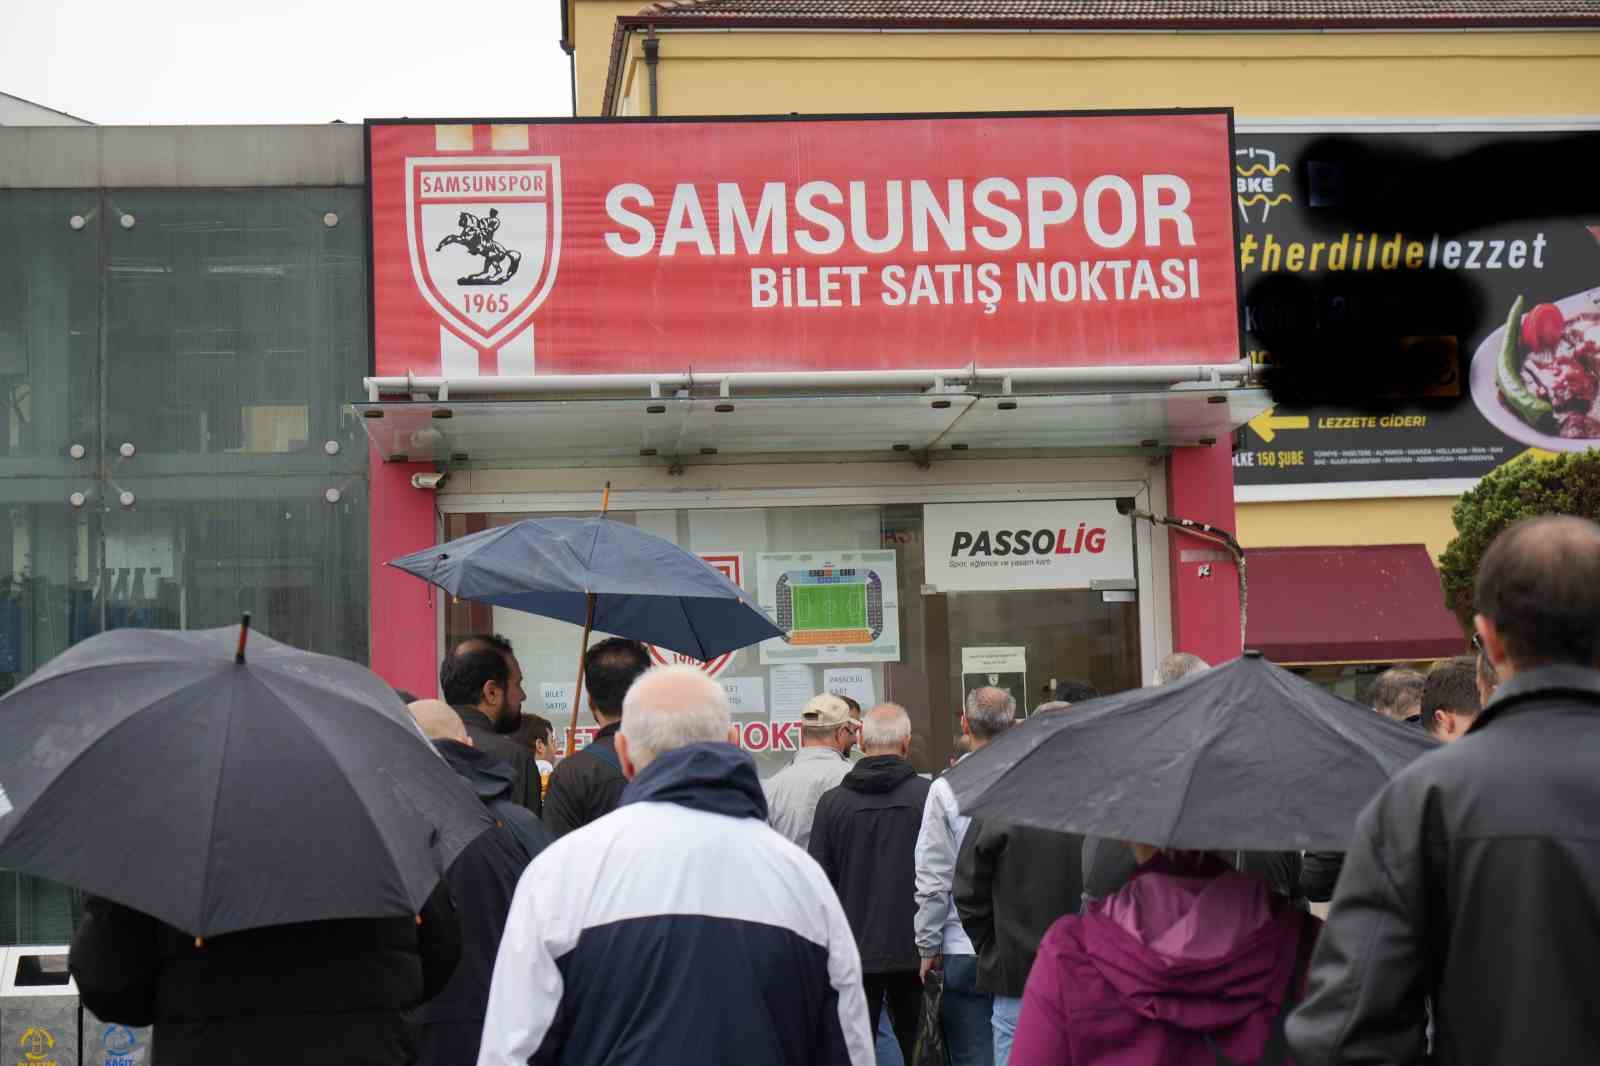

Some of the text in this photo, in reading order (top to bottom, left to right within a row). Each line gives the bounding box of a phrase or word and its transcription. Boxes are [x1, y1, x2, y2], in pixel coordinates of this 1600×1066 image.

[423, 175, 543, 193] SAMSUNSPOR
[1237, 177, 1273, 193] BKE
[604, 174, 1197, 257] SAMSUNSPOR
[881, 263, 1003, 314] SATIŞ
[1016, 258, 1200, 303] NOKTASI
[463, 293, 510, 314] 1965
[1318, 416, 1376, 430] LEZZETE
[1256, 451, 1275, 466] 150
[951, 522, 1107, 557] PASSOLİG
